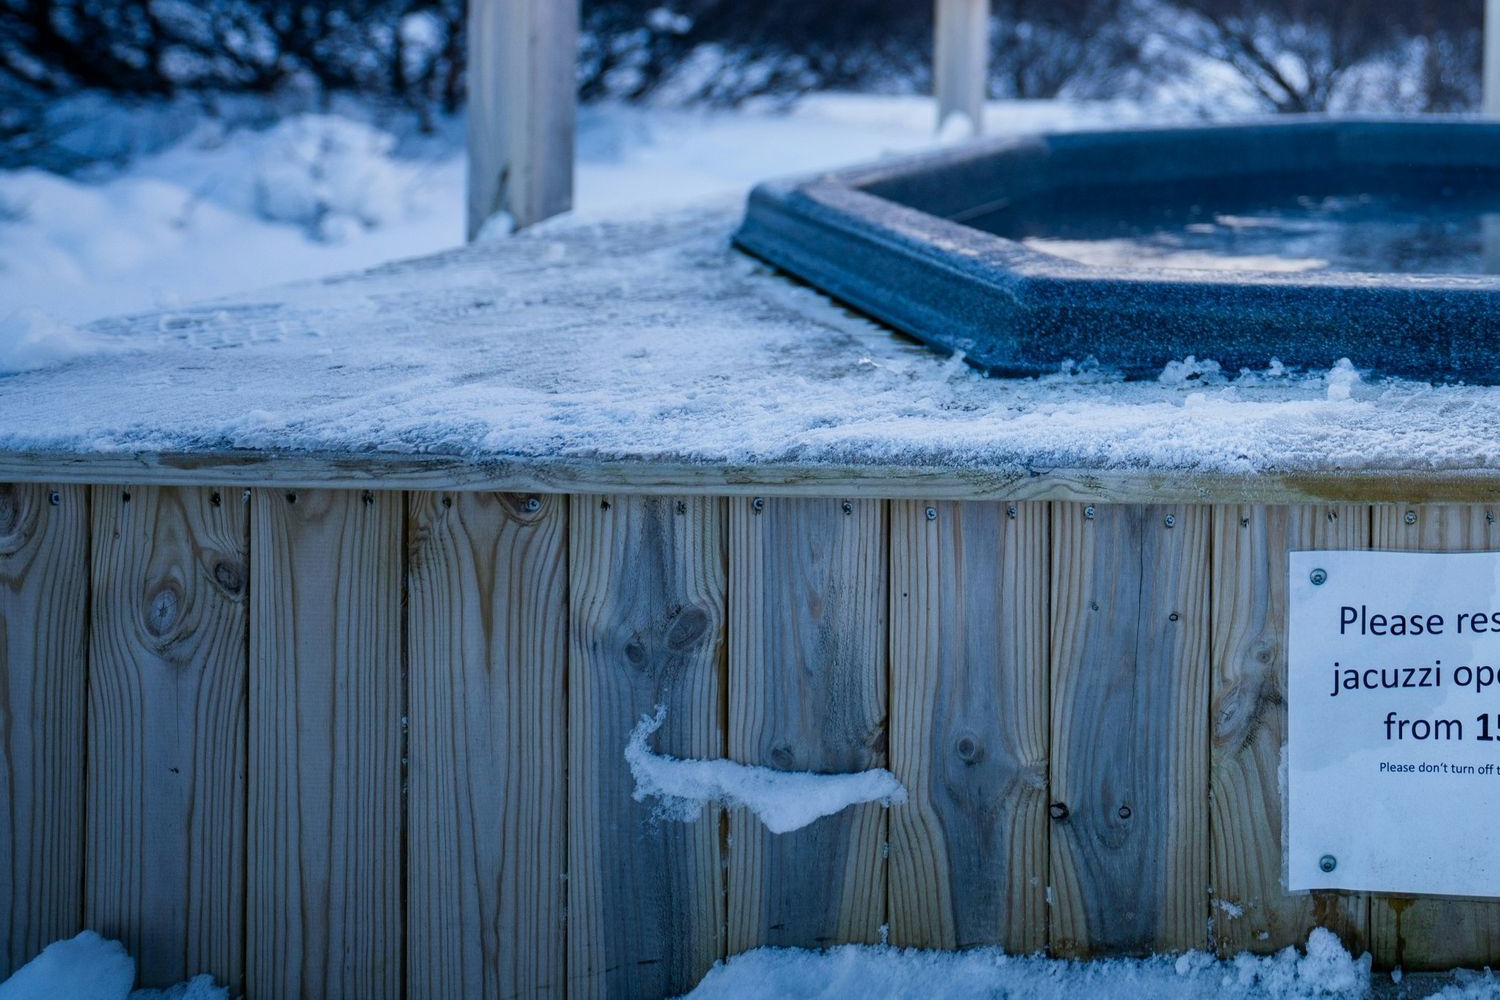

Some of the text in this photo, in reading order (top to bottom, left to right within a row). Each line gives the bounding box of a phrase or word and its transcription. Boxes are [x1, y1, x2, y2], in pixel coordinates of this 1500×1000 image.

[1340, 605, 1444, 636] Please
[1330, 660, 1441, 697] jacuzzi
[1384, 712, 1462, 740] from
[1380, 762, 1415, 772] Please
[1418, 762, 1448, 773] don't
[1451, 763, 1474, 774] turn
[1478, 764, 1494, 775] off
